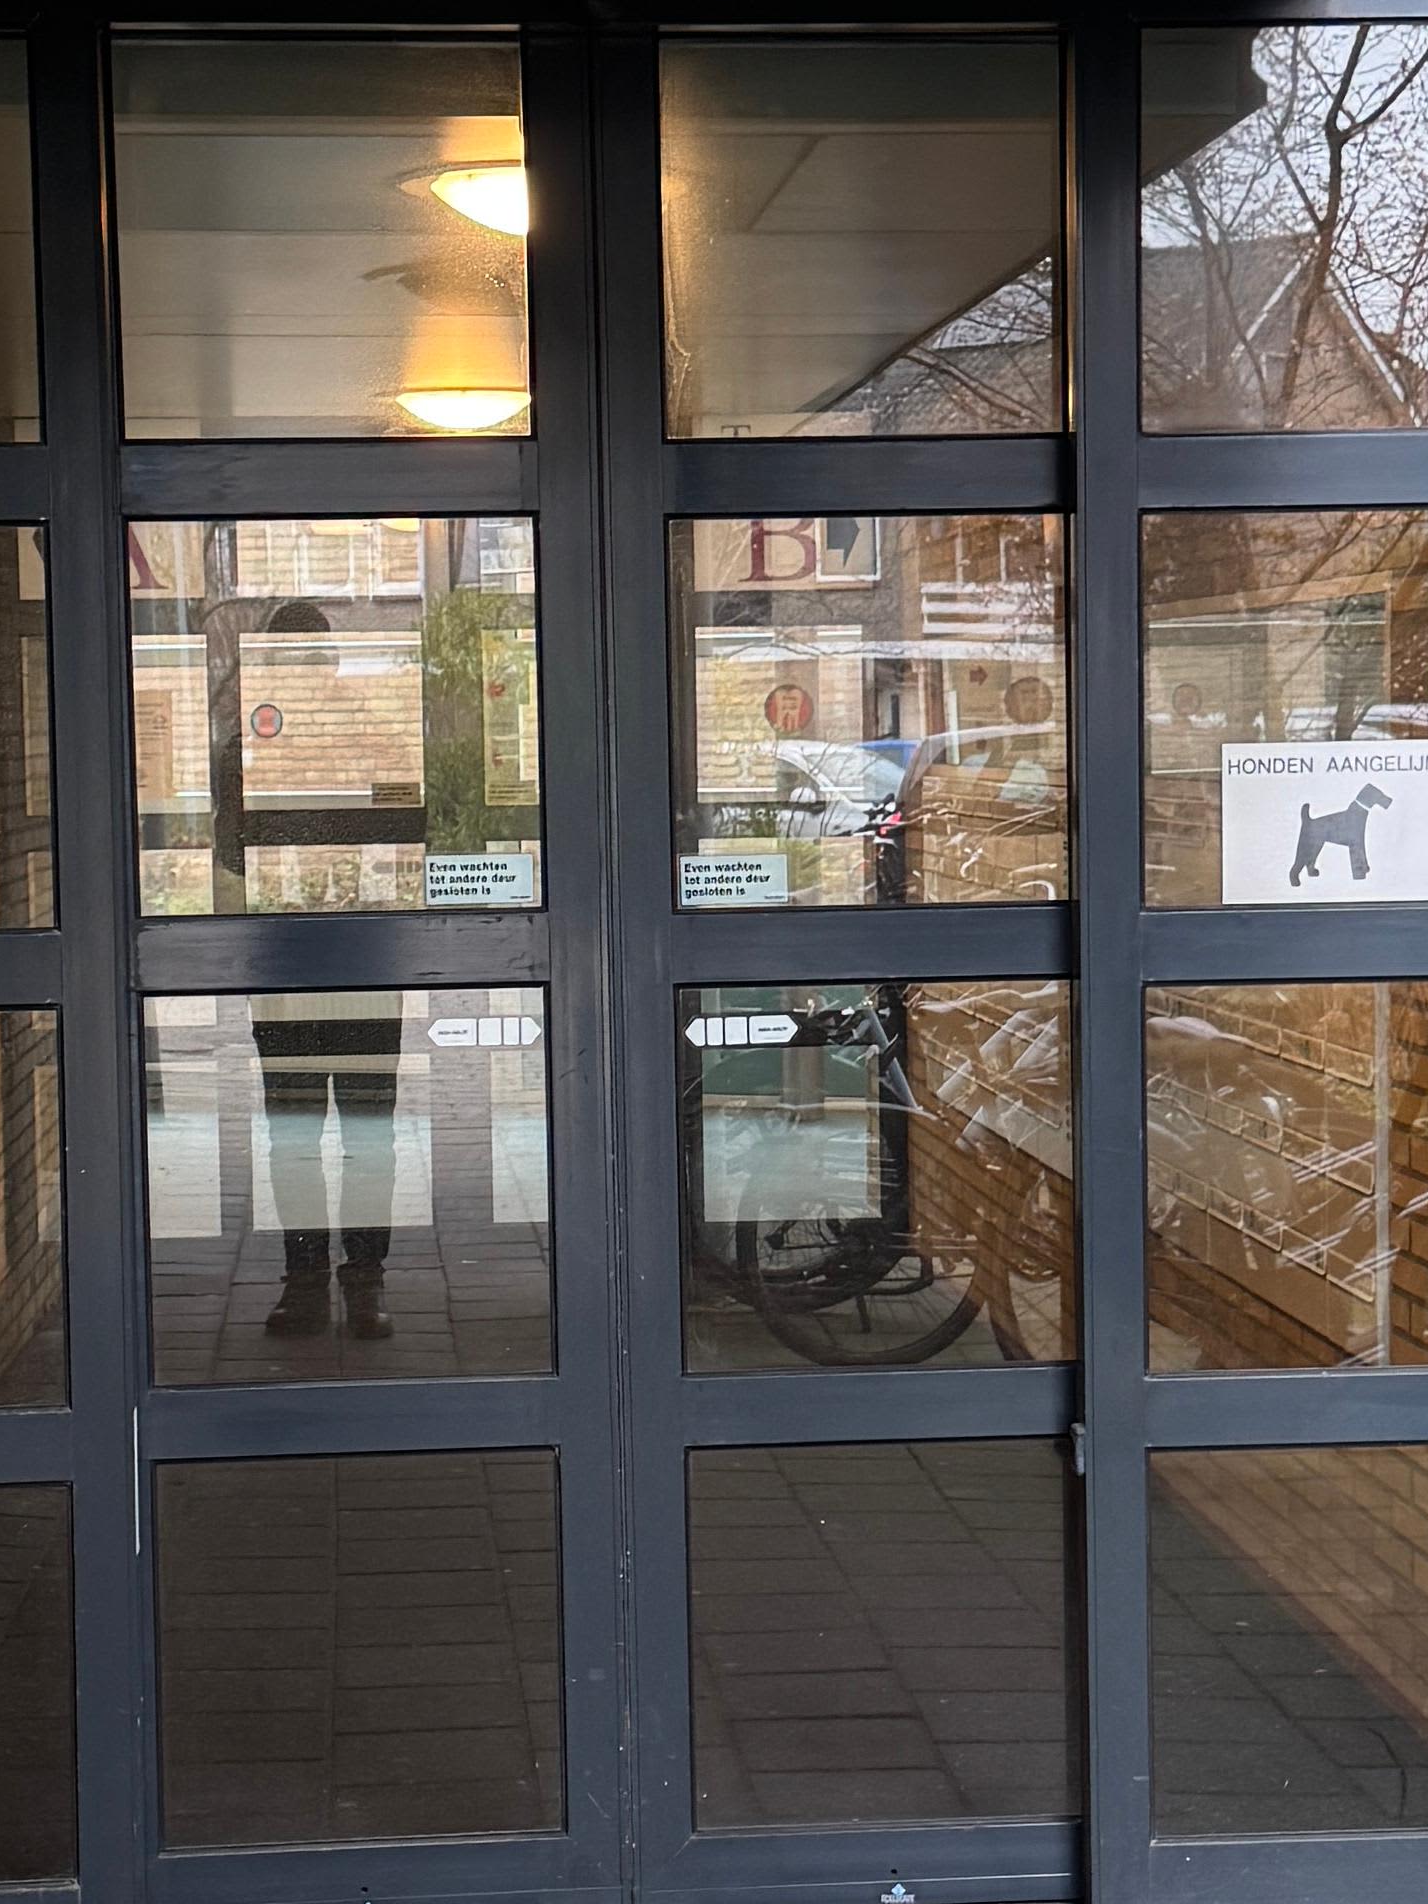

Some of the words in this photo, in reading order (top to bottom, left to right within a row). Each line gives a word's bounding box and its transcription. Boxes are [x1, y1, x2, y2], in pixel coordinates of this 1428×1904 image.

[1227, 757, 1314, 775] HONDEN
[429, 862, 456, 872] Even
[460, 861, 508, 872] wachten
[684, 863, 711, 873] Even
[714, 861, 762, 872] wachten
[430, 875, 445, 884] tot
[449, 874, 487, 884] andere
[491, 873, 516, 883] deur
[685, 876, 700, 885] tot
[704, 874, 742, 884] andere
[745, 874, 771, 883] deur
[430, 886, 478, 899] gesloten
[482, 885, 491, 895] is
[685, 887, 732, 899] gesloten
[736, 886, 746, 895] is
